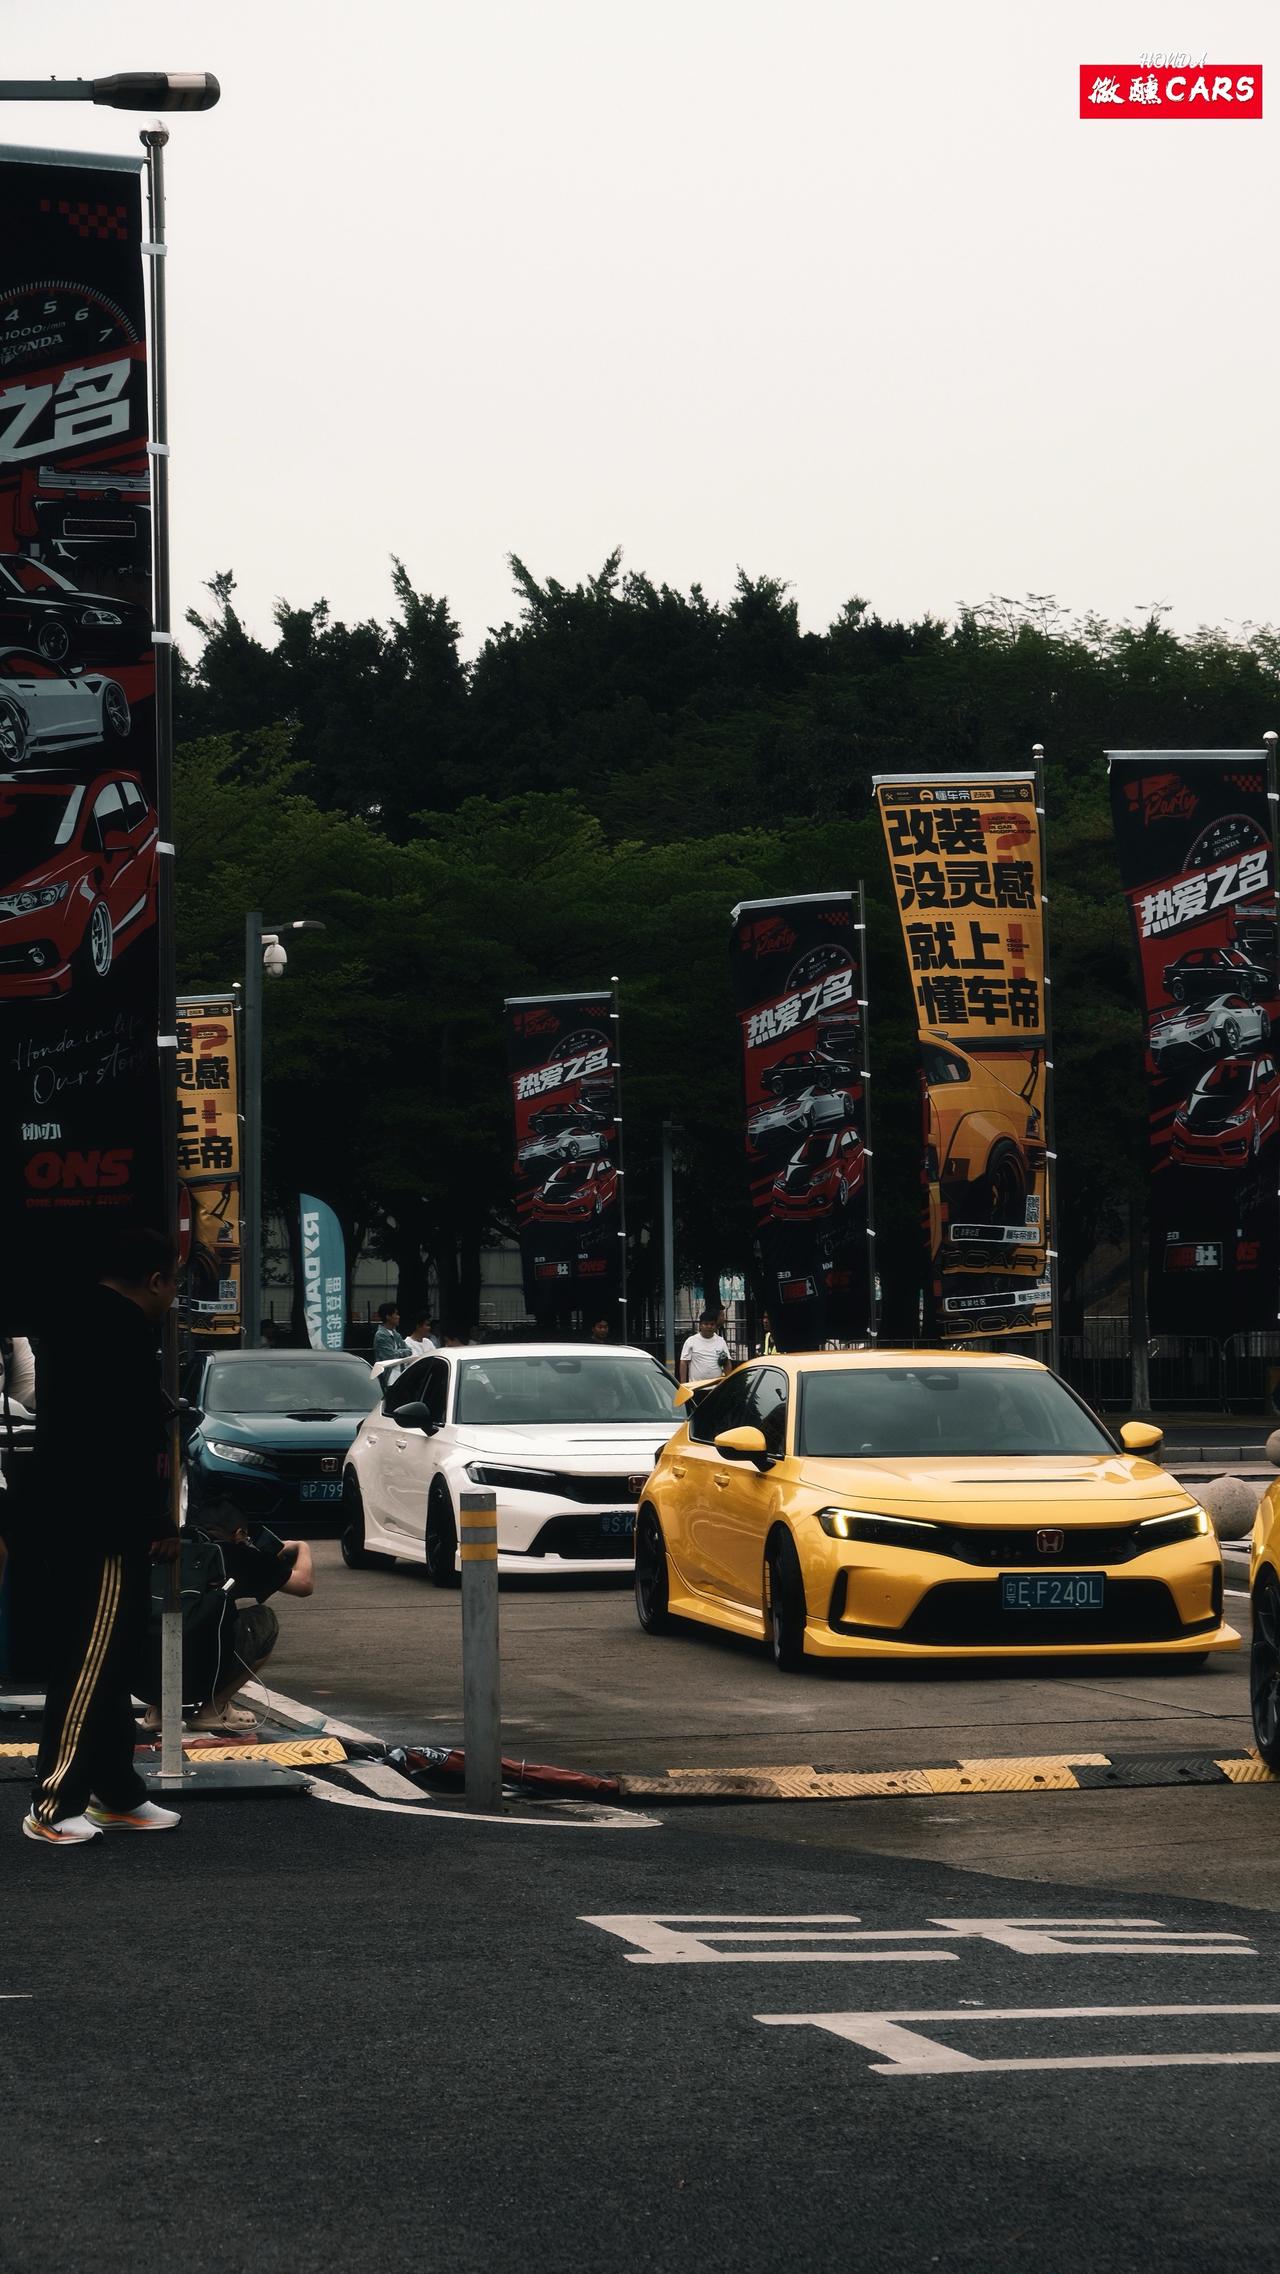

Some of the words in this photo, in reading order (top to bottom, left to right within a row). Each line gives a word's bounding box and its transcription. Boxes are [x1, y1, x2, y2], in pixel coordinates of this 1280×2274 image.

[4, 309, 20, 321] 4
[43, 301, 58, 314] 5
[74, 308, 89, 321] 6
[98, 328, 113, 342] 7
[894, 860, 1037, 909] 没灵感
[1132, 850, 1268, 938] 热爱之名
[741, 969, 853, 1048] 热爱之名
[917, 975, 1039, 1027] 懂车帝
[513, 1047, 608, 1100] 热爱之名
[25, 1148, 135, 1189] ONS
